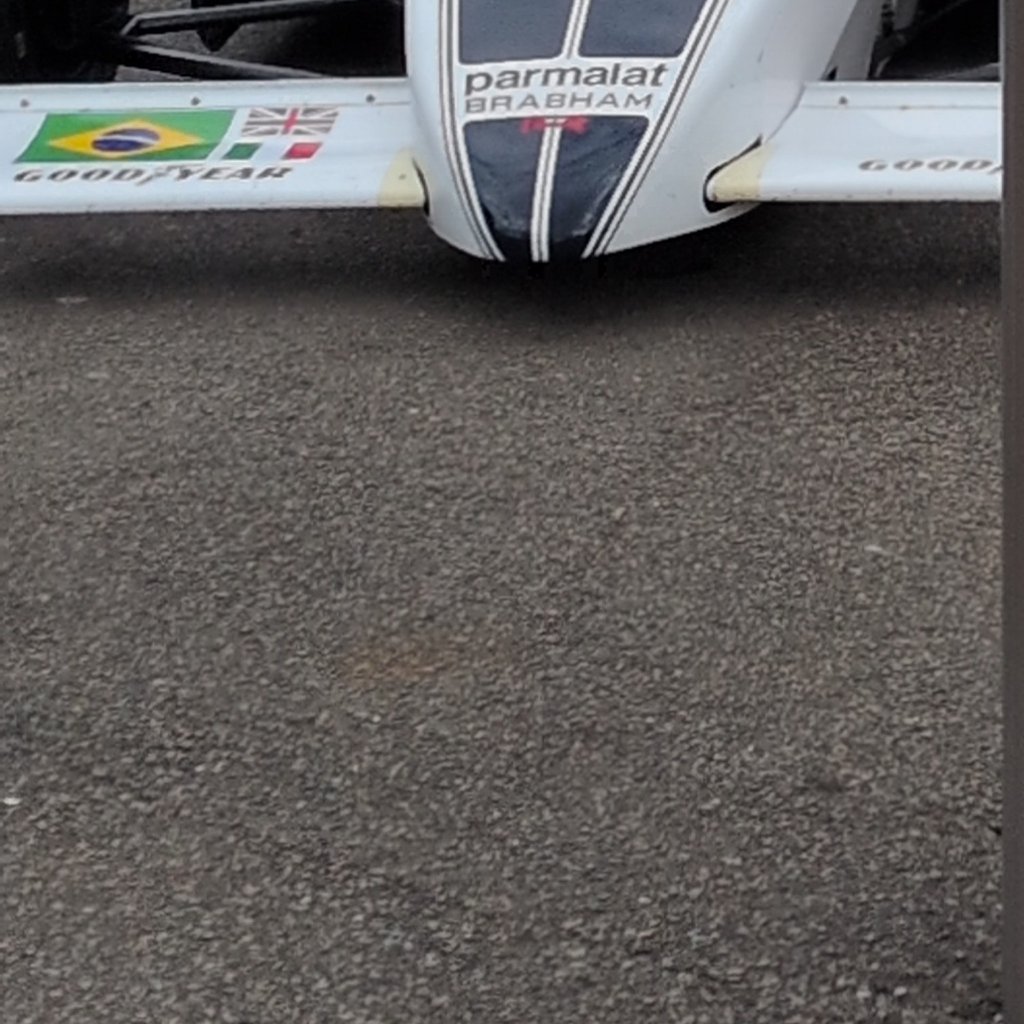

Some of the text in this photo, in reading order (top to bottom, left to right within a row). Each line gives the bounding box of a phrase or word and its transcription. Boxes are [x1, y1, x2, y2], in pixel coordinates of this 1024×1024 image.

[464, 63, 670, 95] parmalat
[464, 92, 653, 114] BRABHAM
[14, 165, 293, 186] GOODYEAR
